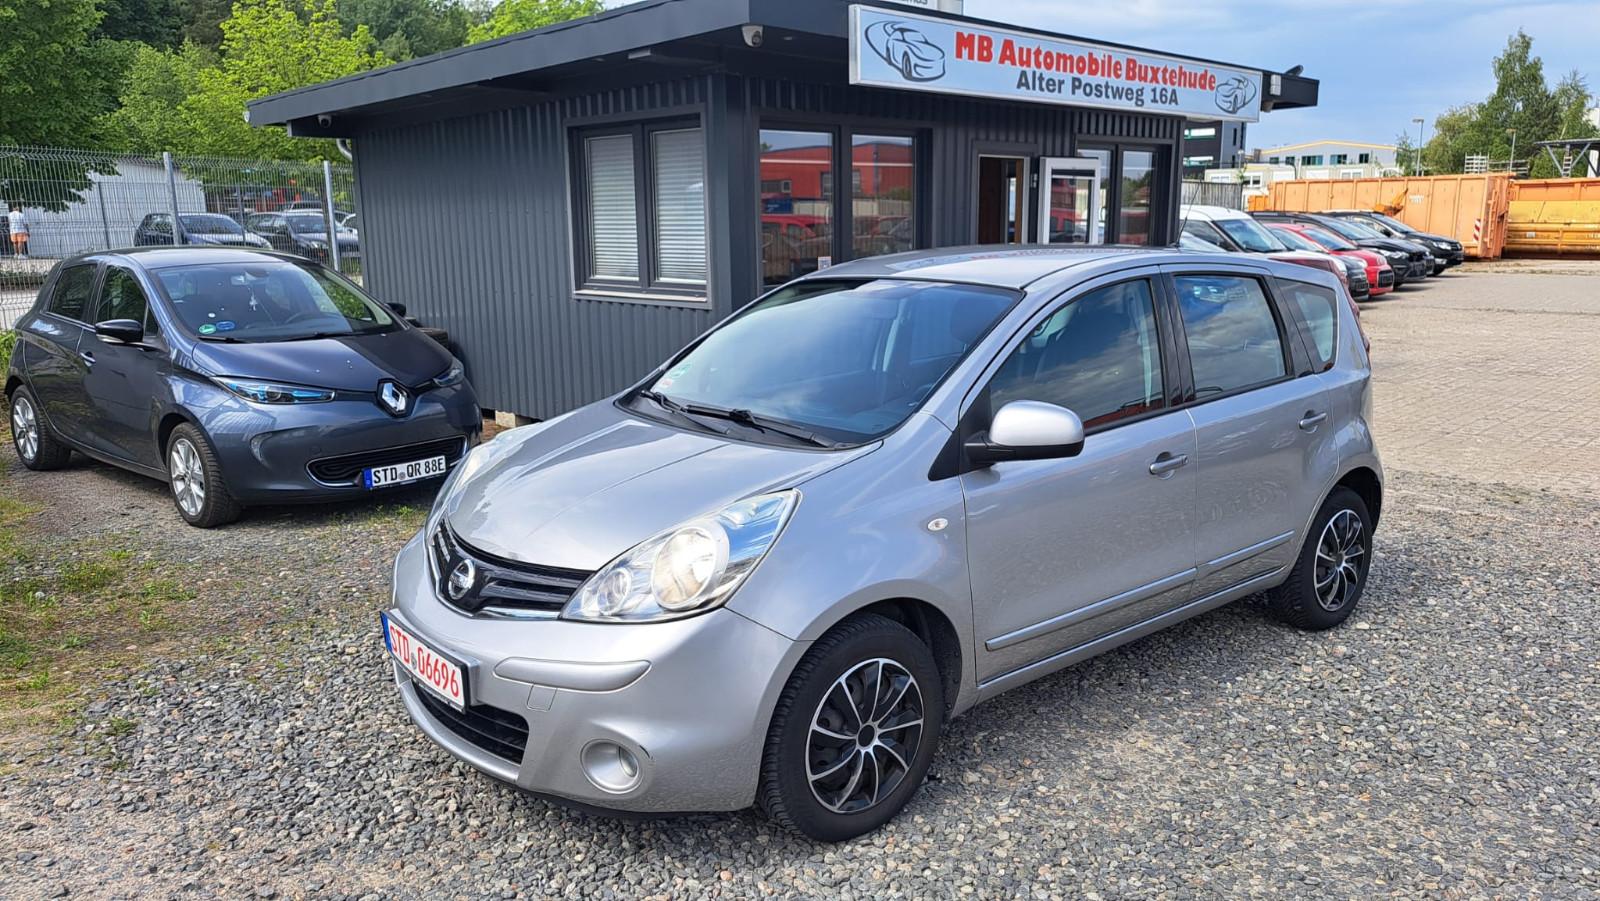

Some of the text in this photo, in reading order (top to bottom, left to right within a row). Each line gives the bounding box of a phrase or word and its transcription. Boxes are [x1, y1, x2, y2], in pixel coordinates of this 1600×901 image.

[955, 31, 1216, 91] MB Automobile Buxtehude
[1016, 70, 1179, 107] Alter Postweg 16A
[373, 458, 445, 484] STD QR 88E
[389, 625, 459, 698] STD 06696
